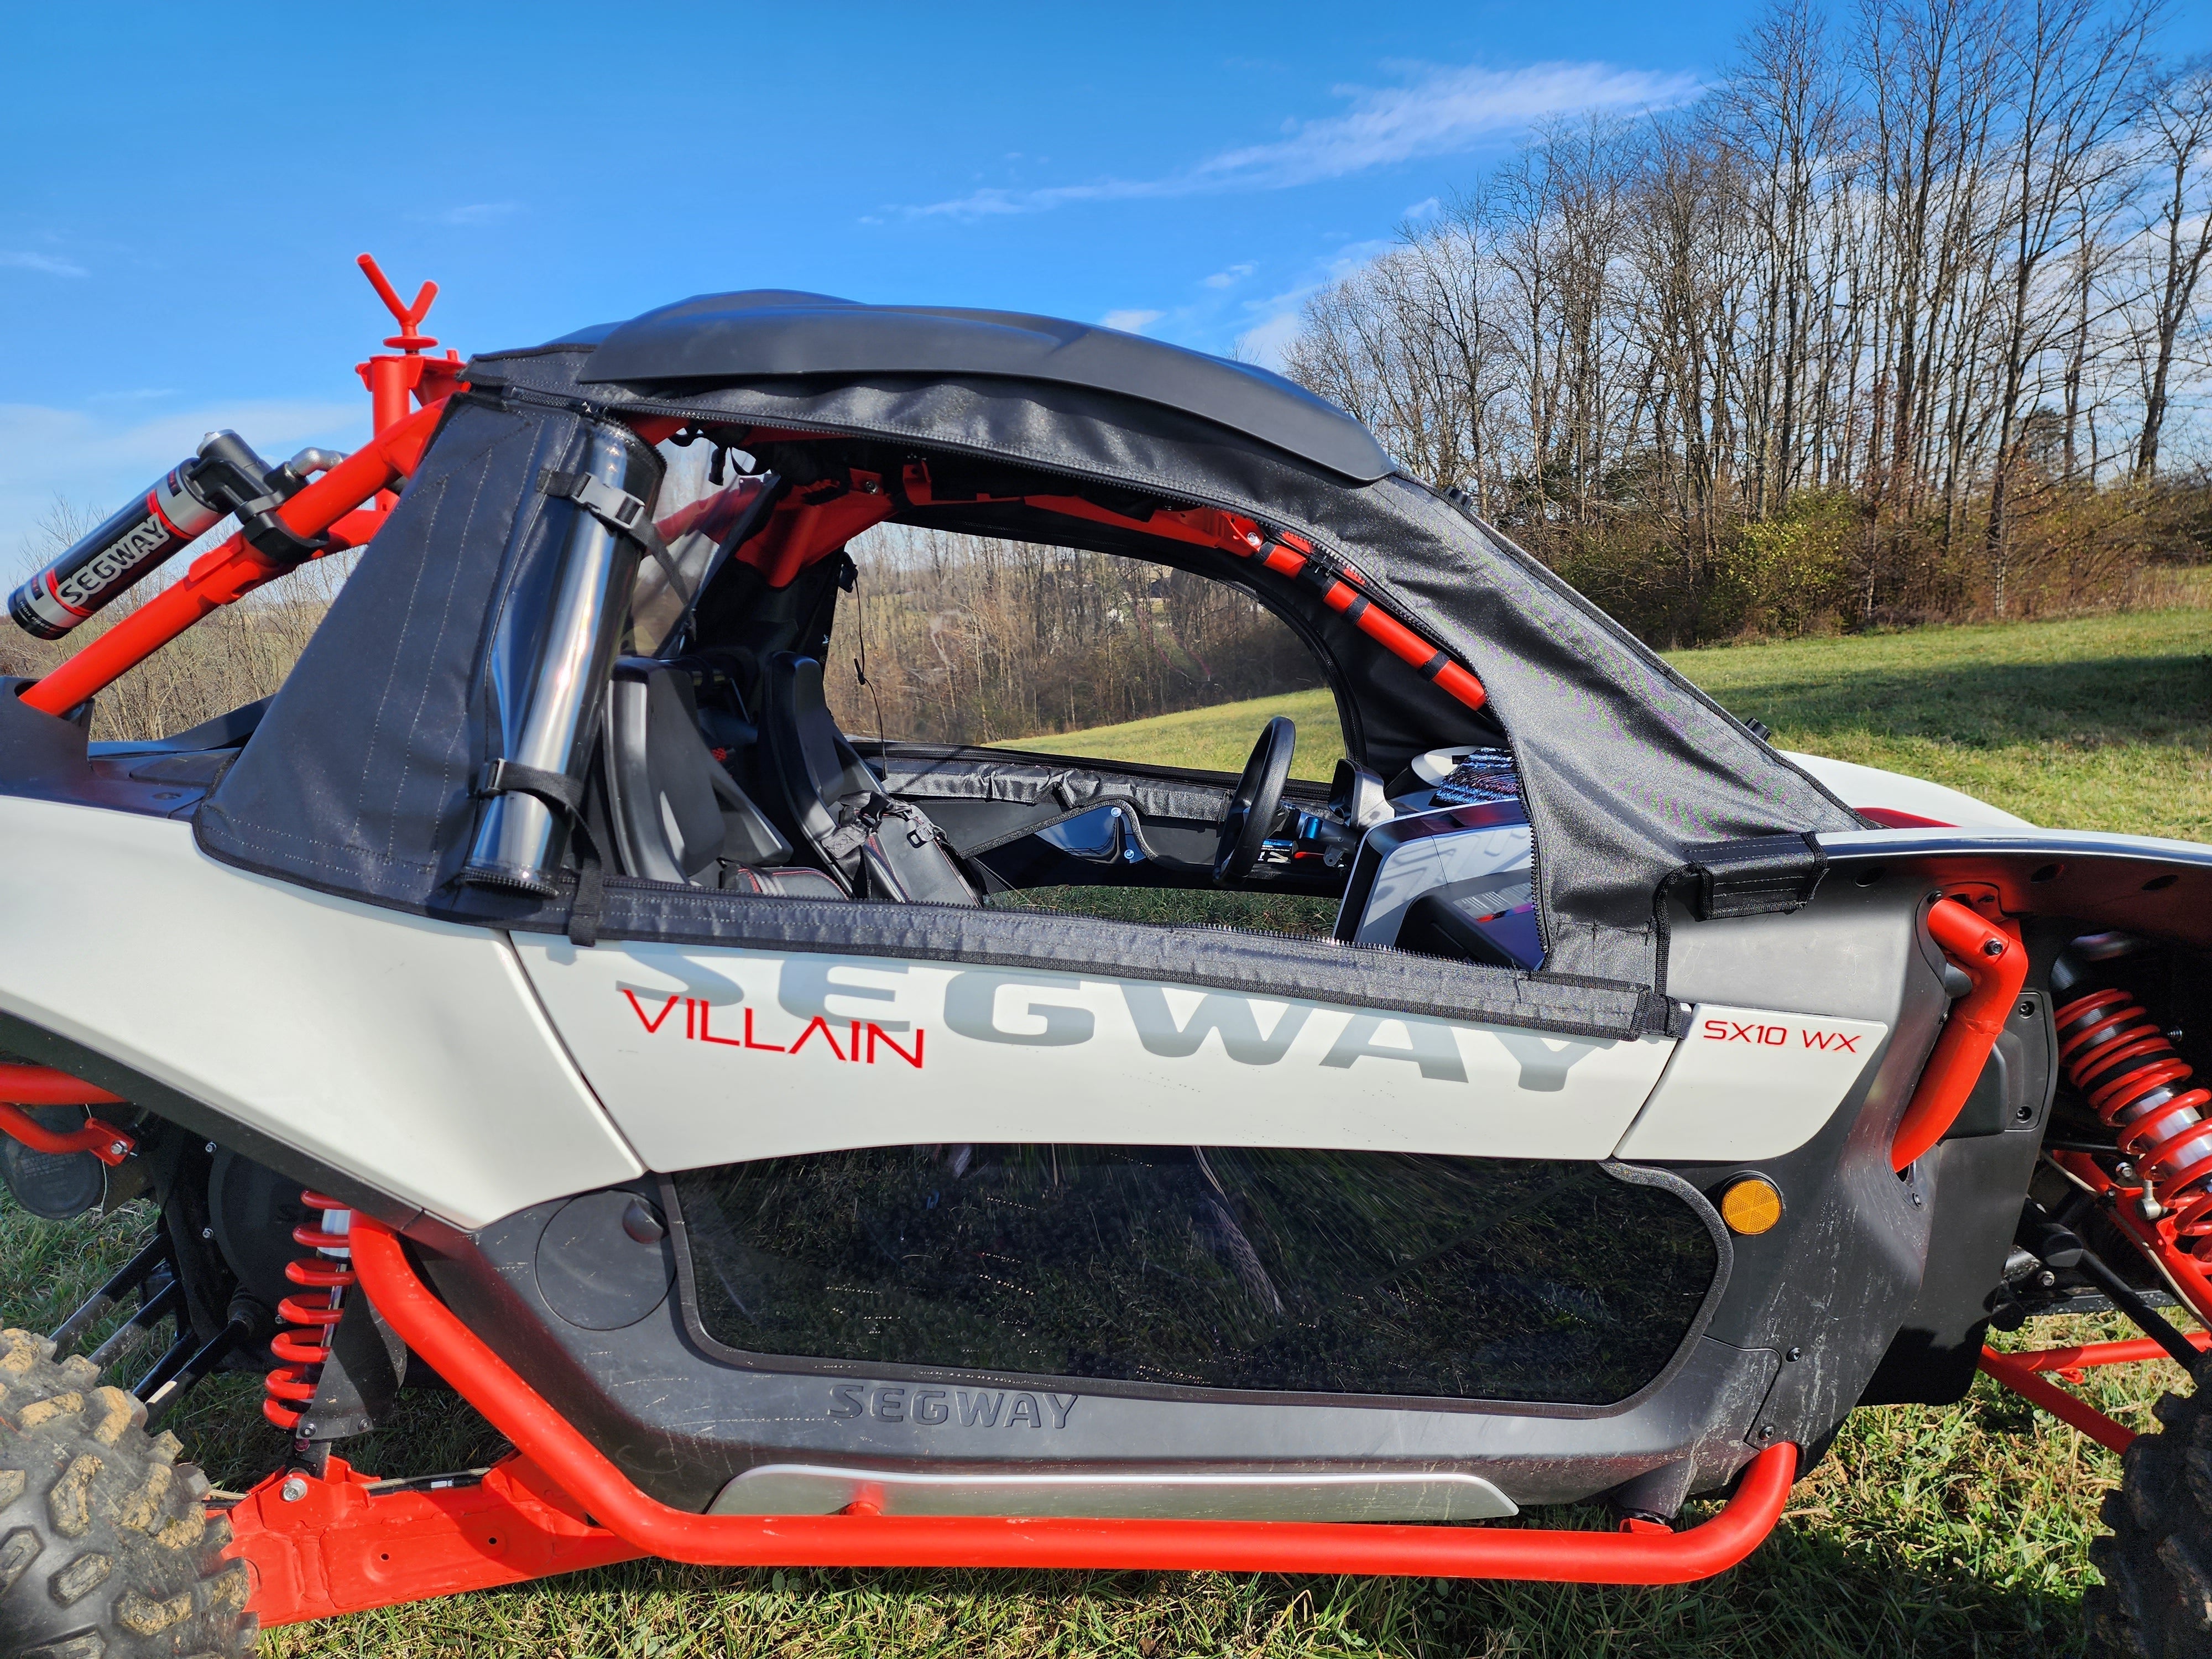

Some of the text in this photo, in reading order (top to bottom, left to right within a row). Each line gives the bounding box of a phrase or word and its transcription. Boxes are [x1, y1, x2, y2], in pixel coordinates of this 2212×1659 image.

[61, 520, 164, 604] SEGWAY
[616, 940, 1601, 1092] SEGWAY
[620, 989, 925, 1069] VILLAIN
[1703, 1020, 1862, 1053] SX10 WX
[827, 1384, 1079, 1428] SEGWAY
